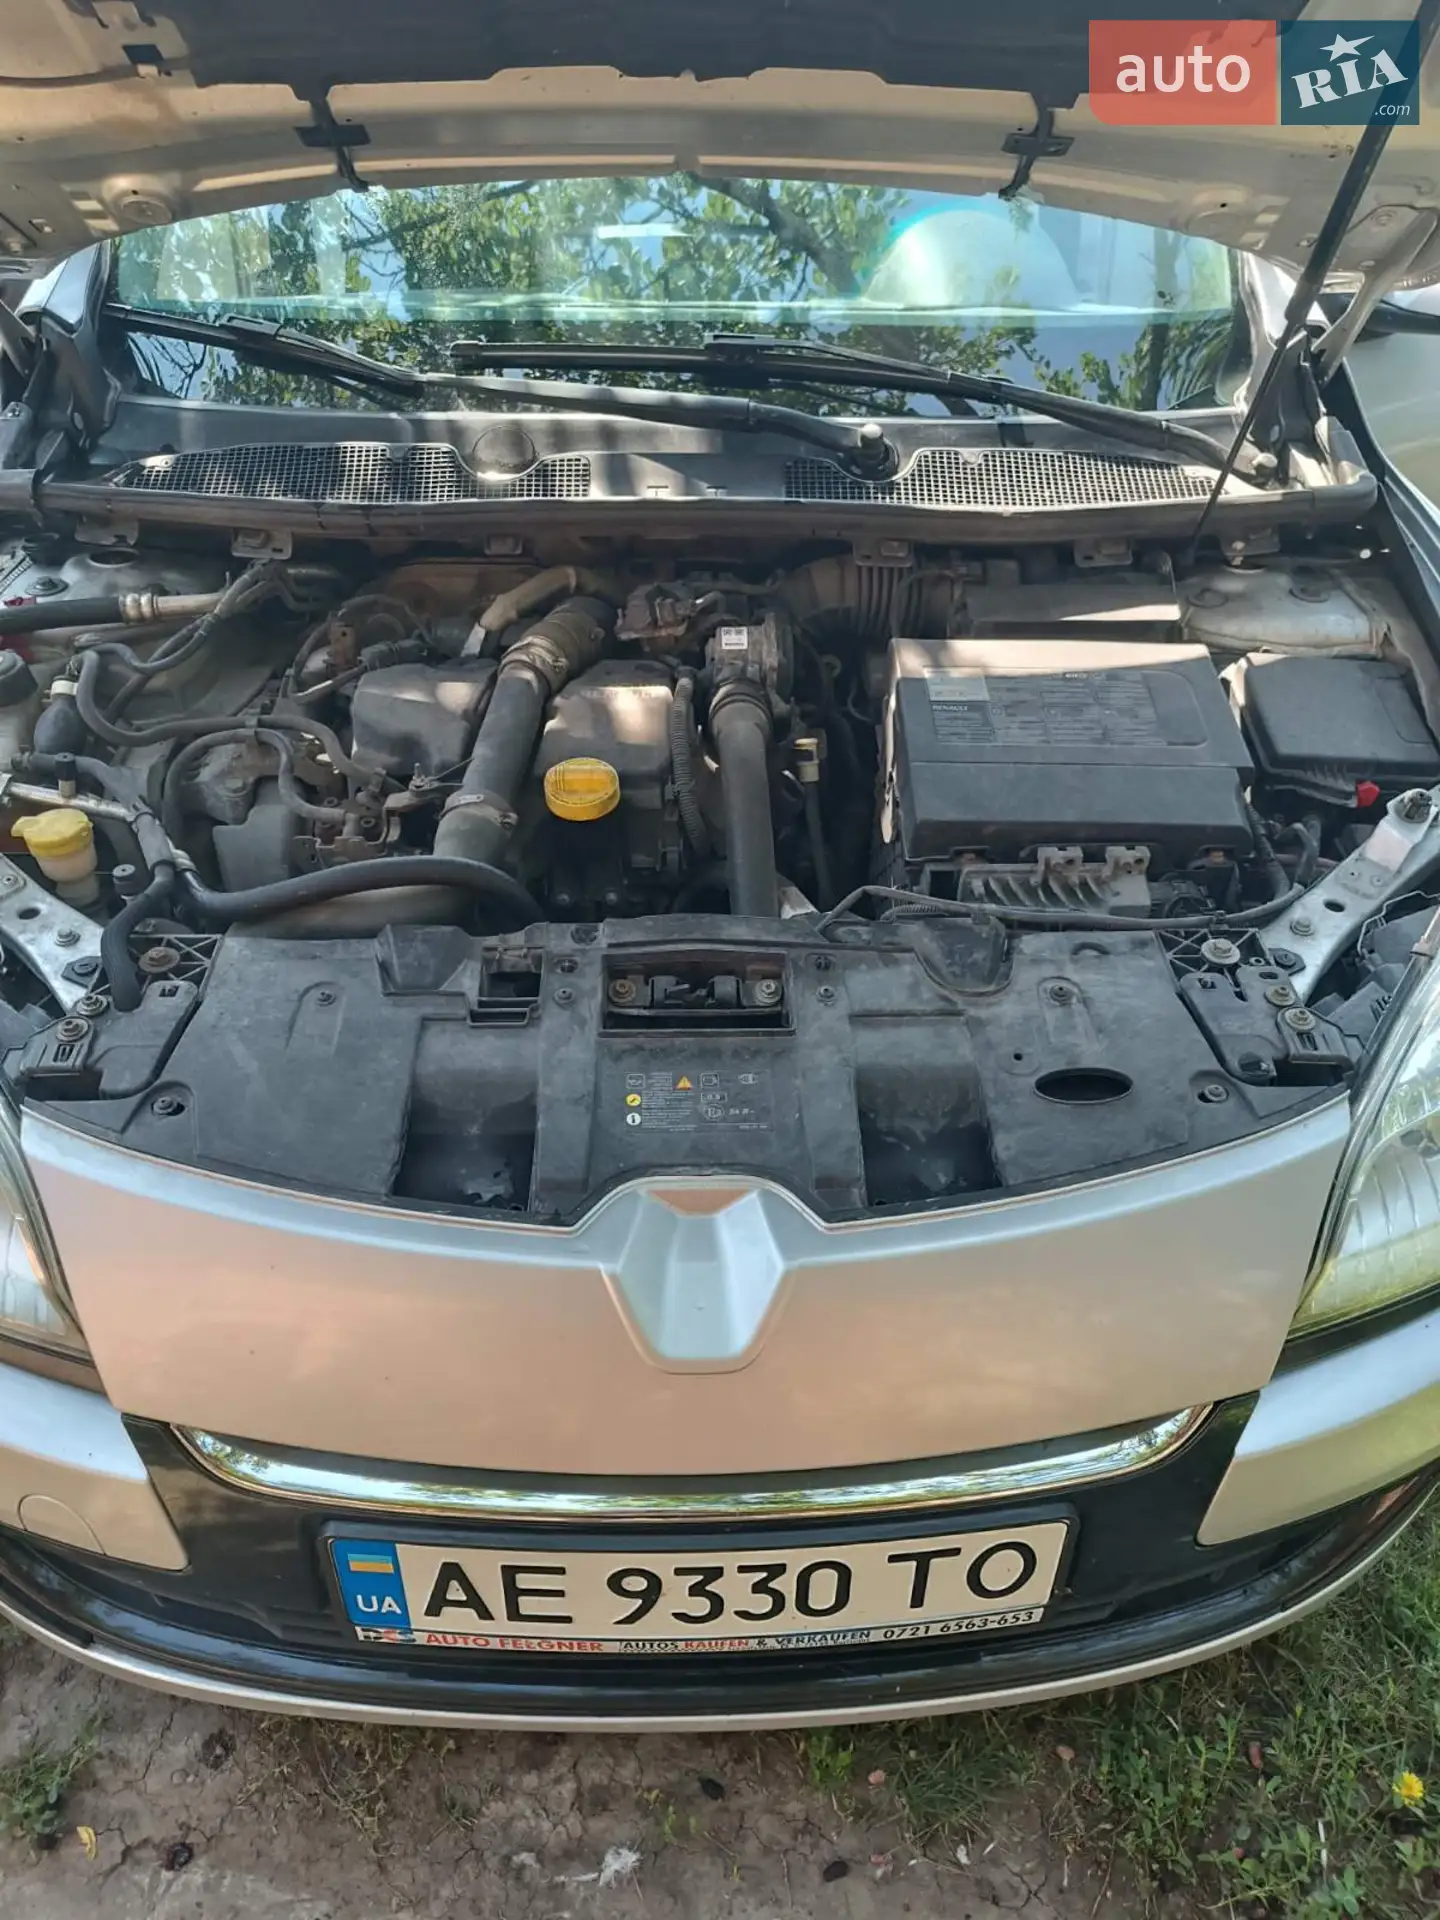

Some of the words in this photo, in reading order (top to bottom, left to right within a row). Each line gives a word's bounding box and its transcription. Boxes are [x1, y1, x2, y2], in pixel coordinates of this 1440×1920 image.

[423, 1561, 573, 1623] AE
[606, 1559, 853, 1625] 9330
[887, 1540, 1038, 1609] TO
[356, 1594, 402, 1616] UA
[425, 1633, 490, 1647] AUTO
[623, 1641, 679, 1650] AUTOS
[684, 1639, 749, 1649] KAUFEN
[755, 1638, 767, 1648] &
[775, 1631, 870, 1646] VERKAUFEN
[883, 1625, 930, 1639] 0721
[940, 1611, 1034, 1633] 6563-653
